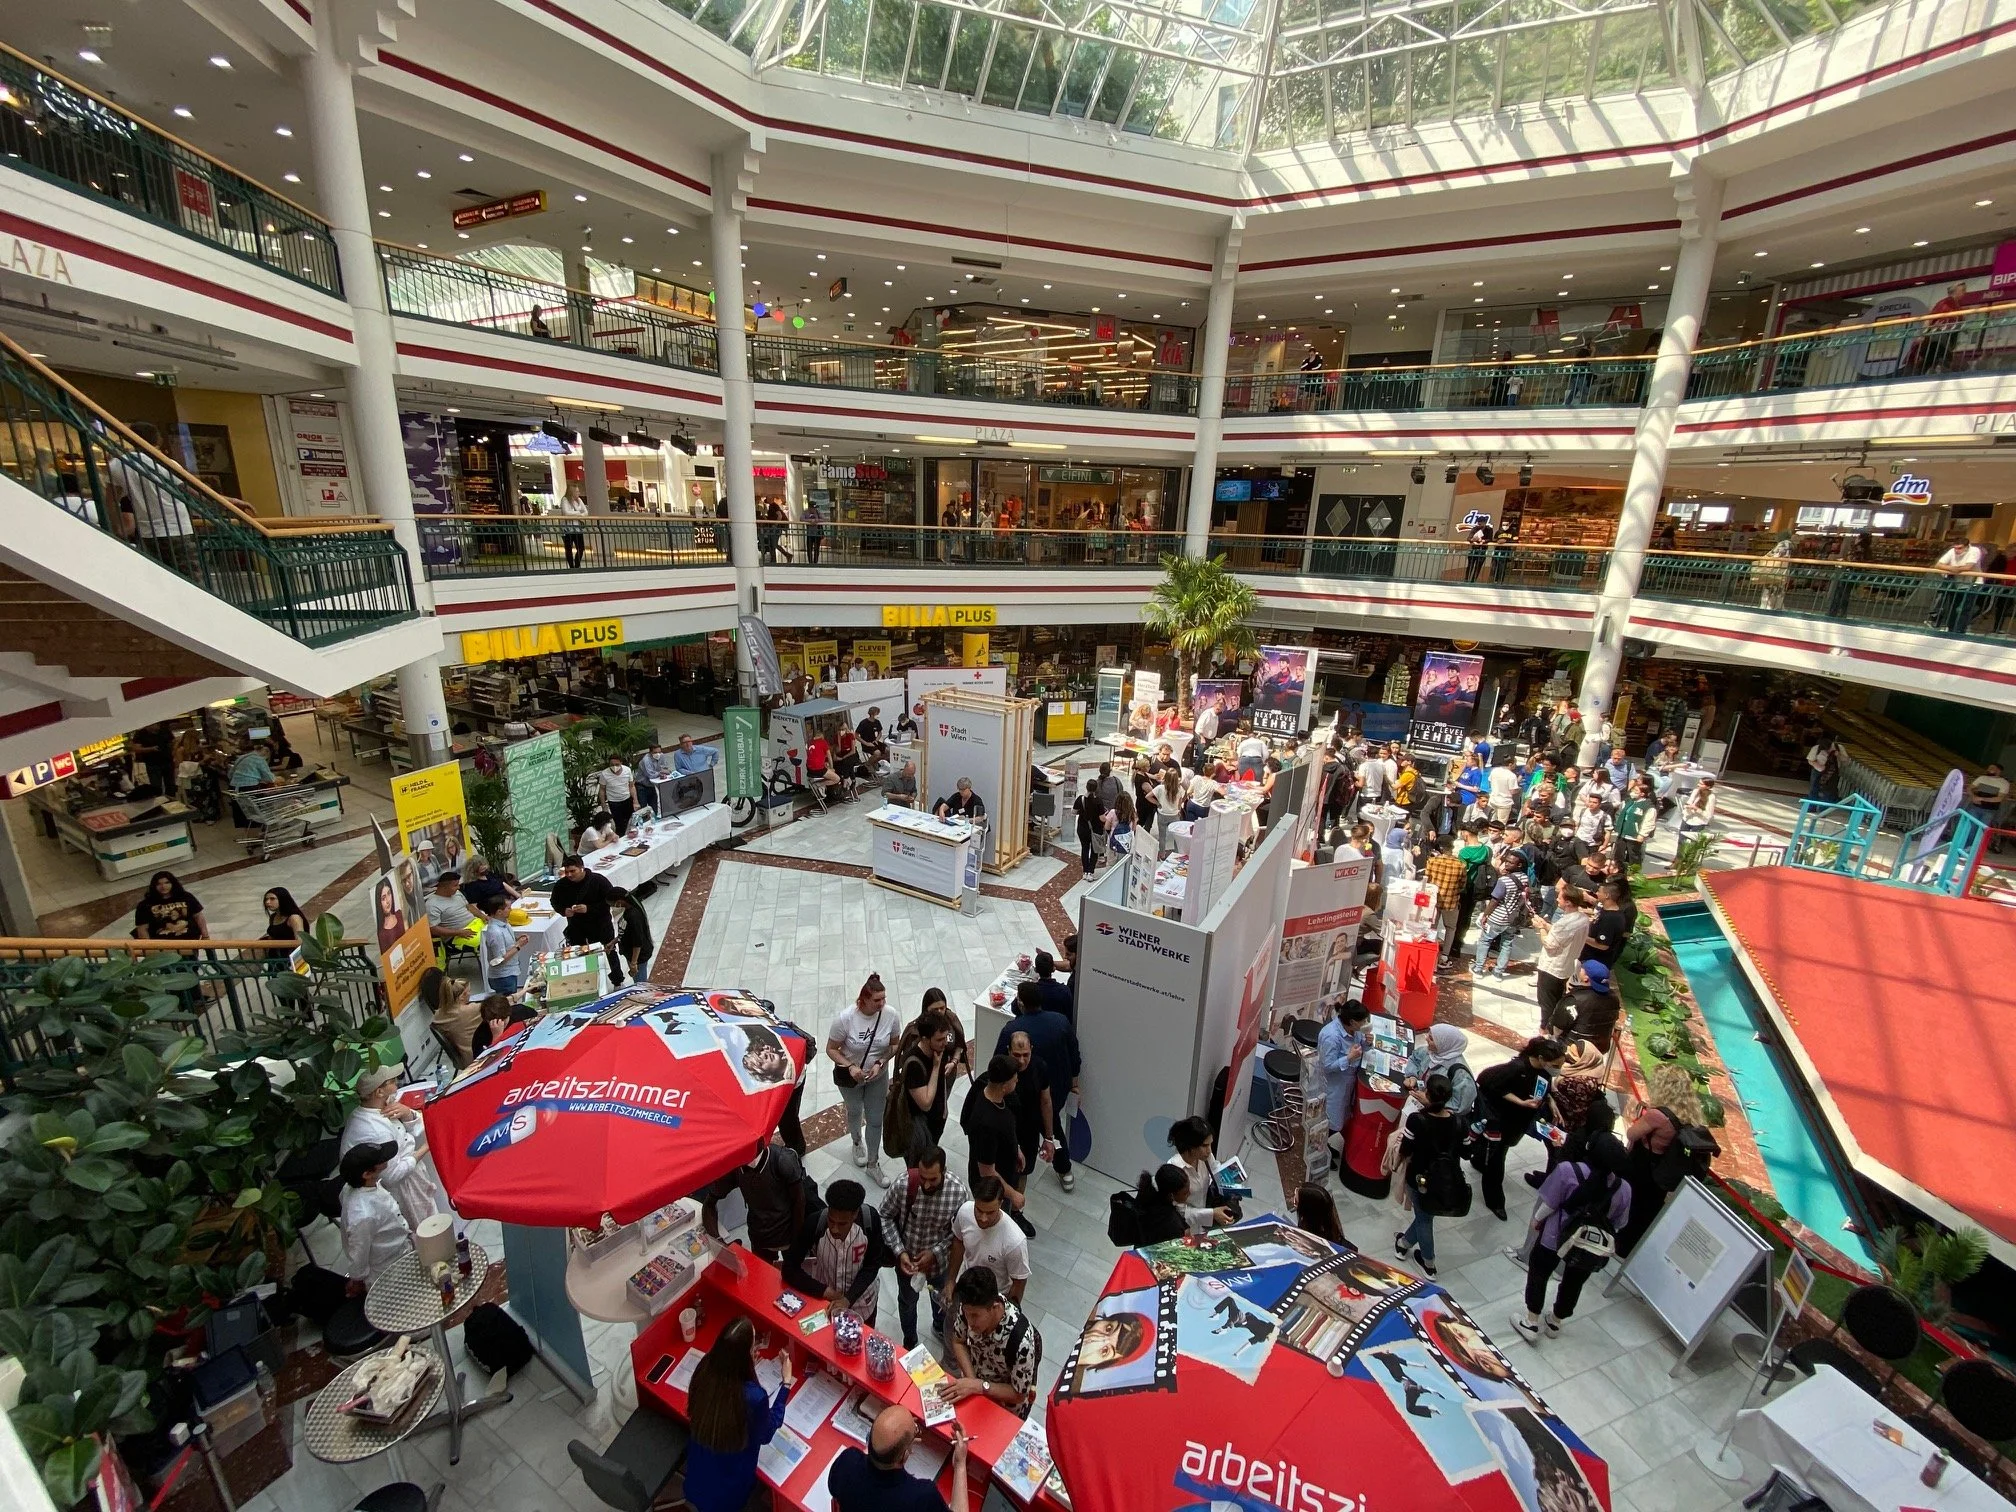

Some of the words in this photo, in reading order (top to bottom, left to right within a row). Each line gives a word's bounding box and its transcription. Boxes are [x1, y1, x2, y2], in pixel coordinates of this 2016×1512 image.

[1993, 271, 2016, 286] BIP
[975, 427, 1015, 441] PLAZA
[1061, 470, 1092, 481] EIFINI
[1892, 476, 1928, 494] dm
[1464, 510, 1489, 525] dm
[882, 605, 951, 627] BILLA
[955, 610, 992, 622] PLUS
[462, 624, 561, 664] BILLA
[571, 625, 618, 645] PLUS
[1254, 717, 1296, 730] LEHRE
[1255, 711, 1272, 719] NEXT
[1276, 714, 1296, 722] LEVEL
[951, 726, 967, 735] Stadt
[1415, 723, 1436, 732] NEXT
[1440, 727, 1464, 736] LEVEL
[951, 733, 967, 741] Wien
[1413, 730, 1462, 745] LEHRE
[737, 732, 746, 765] NEUBAU
[56, 757, 71, 769] WC
[529, 756, 548, 766] NEUBAU
[530, 752, 546, 760] BEZIRK
[35, 762, 48, 776] P
[902, 843, 915, 852] Stadt
[902, 849, 915, 857] Wien
[1307, 910, 1358, 926] Lehrlingsstelle
[1119, 925, 1161, 945] WIENER
[1118, 935, 1190, 964] STADTWERKE
[1092, 968, 1185, 1002] www.wienerstadtwerke.at/lehre
[503, 1076, 690, 1109] arbeitszimmer
[477, 1115, 527, 1151] AMS
